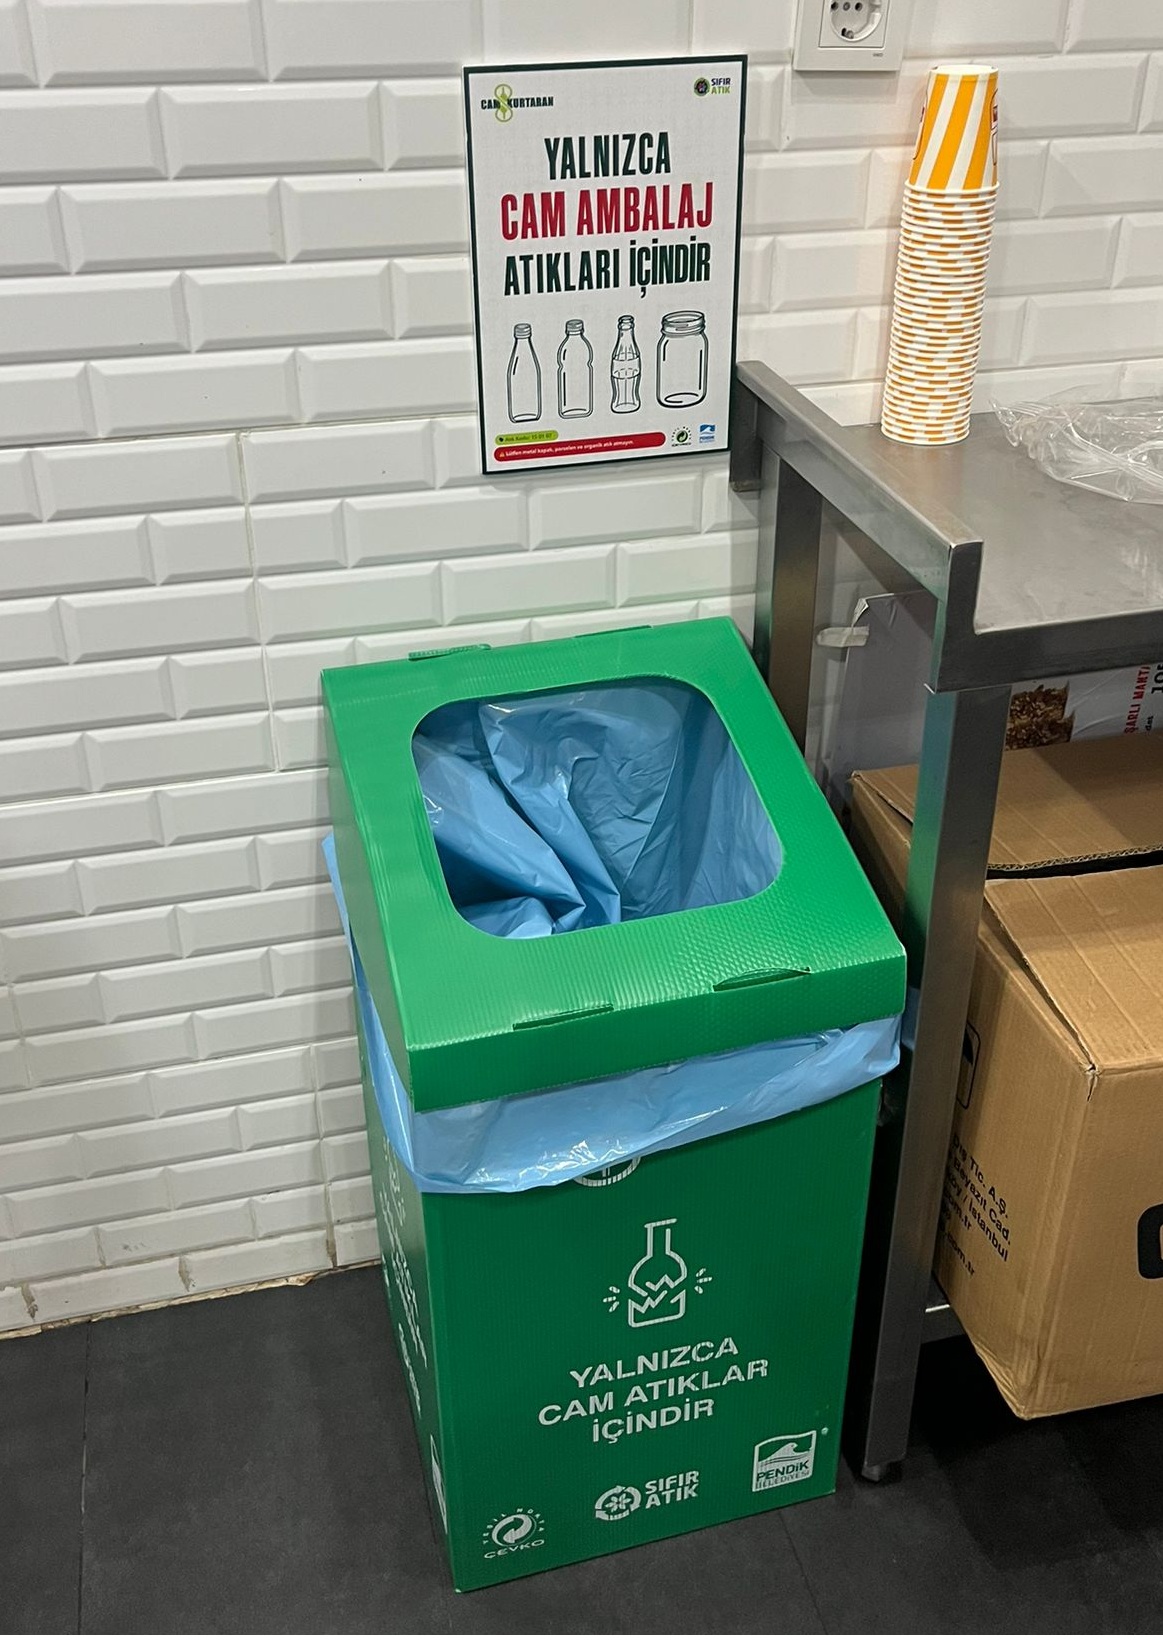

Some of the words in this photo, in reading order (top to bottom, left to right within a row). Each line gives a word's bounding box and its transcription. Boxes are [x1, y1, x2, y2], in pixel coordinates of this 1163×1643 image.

[711, 78, 731, 86] SIFIR
[711, 86, 731, 95] ATIK
[544, 131, 671, 181] YALNIZCA
[500, 191, 566, 241] CAM
[576, 182, 714, 236] AMBALAJ
[504, 248, 620, 296] ATIKLARI
[629, 235, 712, 299] İÇİNDİR
[989, 1207, 1011, 1246] Cad.
[570, 1337, 739, 1388] YALNIZCA
[538, 1391, 614, 1426] CAM
[623, 1358, 769, 1408] ATIKLAR
[592, 1398, 715, 1445] İÇİNDİR
[645, 1470, 699, 1495] SIFIR
[756, 1459, 810, 1482] PENDİK
[645, 1483, 699, 1509] ATIK
